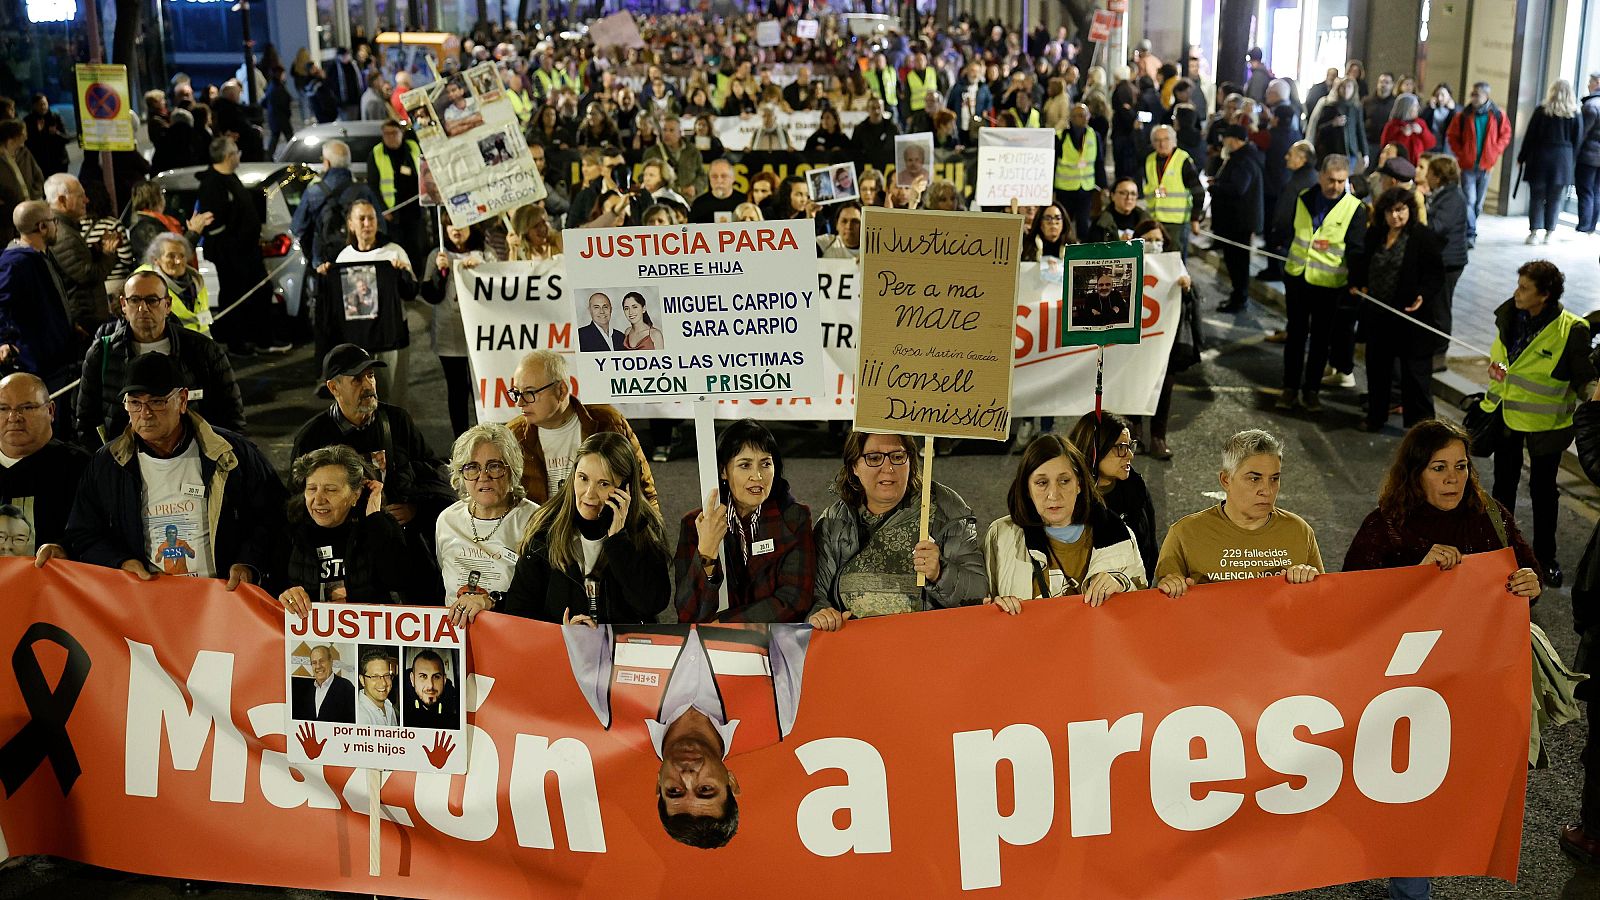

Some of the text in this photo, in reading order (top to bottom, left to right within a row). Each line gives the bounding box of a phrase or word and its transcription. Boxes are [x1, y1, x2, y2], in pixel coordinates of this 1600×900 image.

[999, 167, 1047, 180] JUSTICIA
[988, 183, 1049, 199] ASESINOS
[718, 228, 799, 253] PARA
[638, 261, 744, 277] PADRE E HIJA
[818, 273, 856, 300] RE
[878, 270, 985, 299] Per a ma
[663, 291, 813, 314] MIGUEL CARPIO Y
[681, 316, 798, 338] SARA CARPIO
[476, 324, 539, 351] HAN
[820, 322, 856, 348] TR
[893, 344, 923, 357] Rosa
[595, 351, 804, 372] Y TODAS LAS VICTIMAS
[610, 369, 792, 395] MAZÓN PRISIÓN
[155, 500, 195, 516] PRESÓ
[1222, 548, 1288, 558] 229 fallecidos
[1220, 558, 1292, 568] 0 responsables
[1207, 571, 1254, 581] VALENCIA
[291, 608, 460, 643] JUSTICIA
[333, 726, 415, 740] por mi marido
[343, 742, 406, 757] y mis hijos
[794, 736, 892, 857] a
[953, 630, 1452, 891] presó
